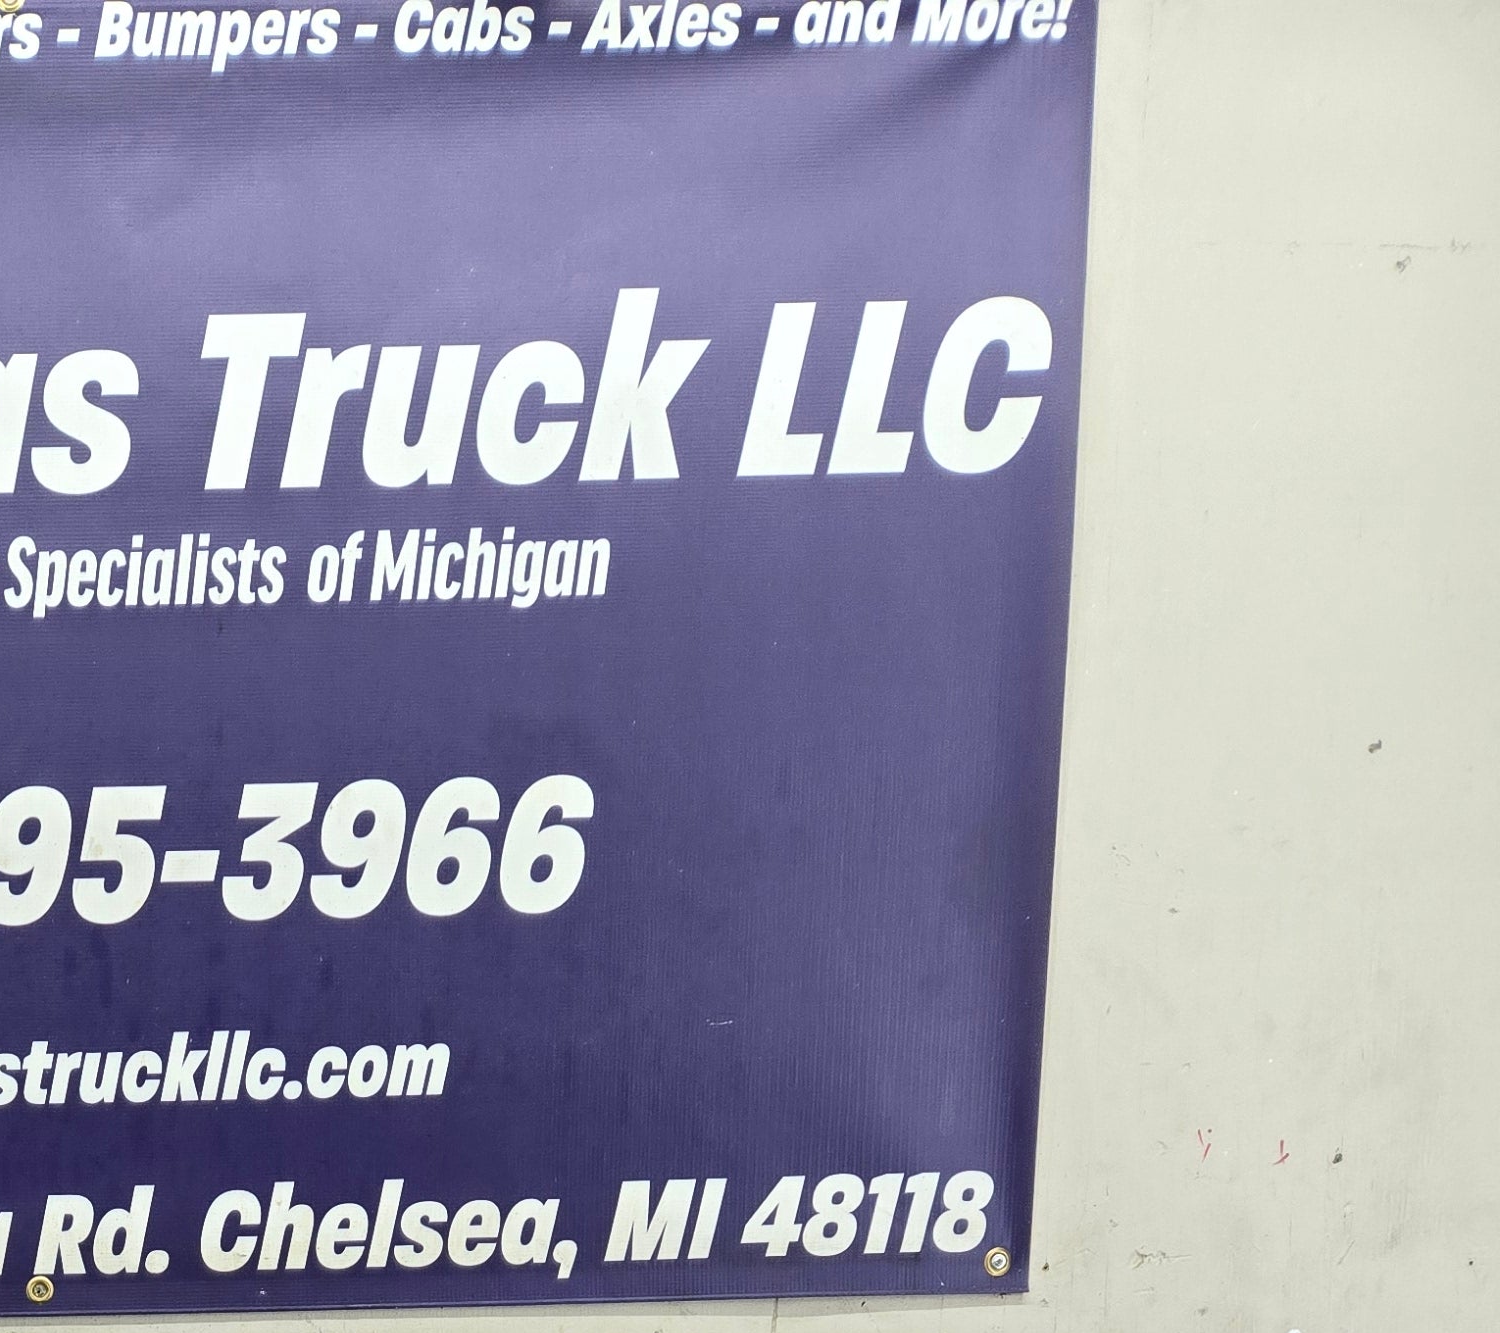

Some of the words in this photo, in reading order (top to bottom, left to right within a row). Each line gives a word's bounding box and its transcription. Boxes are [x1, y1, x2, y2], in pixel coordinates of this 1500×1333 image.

[93, 0, 341, 75] Bumpers
[393, 0, 535, 55] Cabs
[581, 0, 743, 52] Axles
[793, 0, 902, 48] and
[910, 0, 1074, 46] More!
[200, 286, 712, 491] Truck
[736, 295, 1053, 478] LLC
[3, 533, 287, 619] Specialists
[307, 529, 365, 604] of
[369, 526, 611, 610] Michigan
[33, 1184, 170, 1276] Rd.
[200, 1178, 578, 1280] Chelsea,
[603, 1178, 728, 1262] MI
[740, 1170, 995, 1258] 48118
